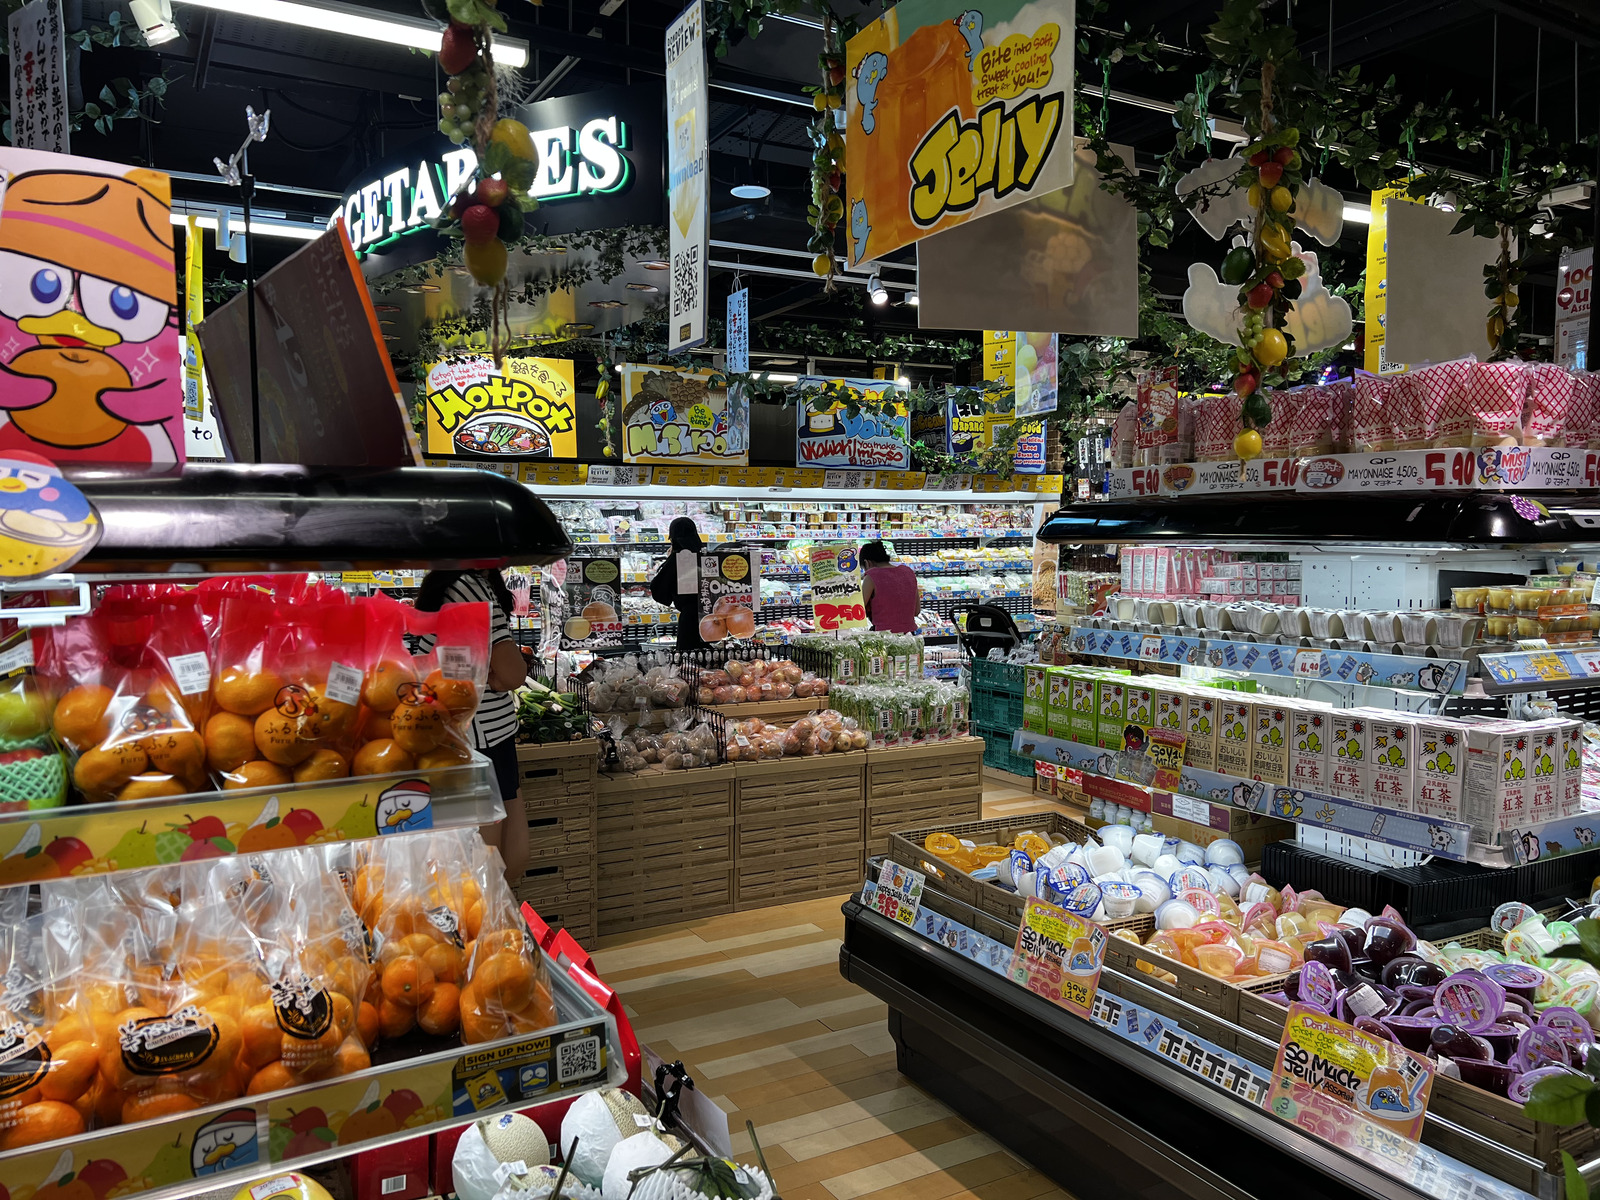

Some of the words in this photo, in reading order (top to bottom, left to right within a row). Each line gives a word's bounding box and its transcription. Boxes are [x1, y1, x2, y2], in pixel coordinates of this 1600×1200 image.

[667, 23, 696, 64] REVIEW
[981, 47, 1011, 73] Bite
[1014, 42, 1032, 56] into
[23, 51, 35, 149] 幸せなんだ
[977, 84, 999, 100] treat
[330, 115, 621, 252] GETABES
[1557, 287, 1590, 310] Qu
[511, 361, 567, 398] 鍋を食べる
[694, 405, 705, 415] Be
[952, 417, 984, 433] Japane
[1485, 421, 1516, 431] マヨネーズ
[192, 426, 213, 441] to
[1369, 457, 1396, 465] QP
[1502, 452, 1529, 468] MUST
[1550, 452, 1571, 460] QP
[1348, 466, 1394, 479] MAYONNAISE
[1397, 466, 1417, 478] 450G
[1508, 466, 1526, 483] TRY
[1532, 461, 1566, 476] MAYONNAISE
[1566, 461, 1580, 476] 450G
[1200, 470, 1239, 484] MAYONNAISE
[1244, 471, 1259, 482] 50G
[1373, 479, 1403, 487] マヨネーズ
[710, 580, 751, 594] Onion
[814, 603, 866, 630] 2.50
[264, 722, 321, 737] ふるふる
[393, 723, 410, 731] Furu
[412, 723, 433, 731] Furu
[270, 737, 292, 745] Furu
[1187, 739, 1211, 749] おいしい
[1220, 745, 1245, 757] おいしい
[1255, 751, 1281, 763] おいしい
[1218, 754, 1248, 767] 無調整豆乳
[1254, 760, 1285, 774] 無調整豆乳
[1294, 763, 1320, 779] 紅茶
[1333, 771, 1360, 787] 紅茶
[1374, 778, 1403, 796] 紅茶
[1420, 785, 1452, 803] 紅茶
[1565, 784, 1579, 800] 紅茶
[1503, 795, 1523, 812] 紅茶
[1534, 790, 1553, 806] 紅茶
[1066, 982, 1088, 996] save
[1291, 1025, 1314, 1038] First
[1302, 1016, 1329, 1033] Don't
[467, 1052, 495, 1065] SIGN
[498, 1047, 514, 1058] UP
[517, 1039, 549, 1053] NOW!
[1284, 1060, 1324, 1089] Jelly
[1280, 1098, 1289, 1109] 3
[1365, 1125, 1401, 1147] save
